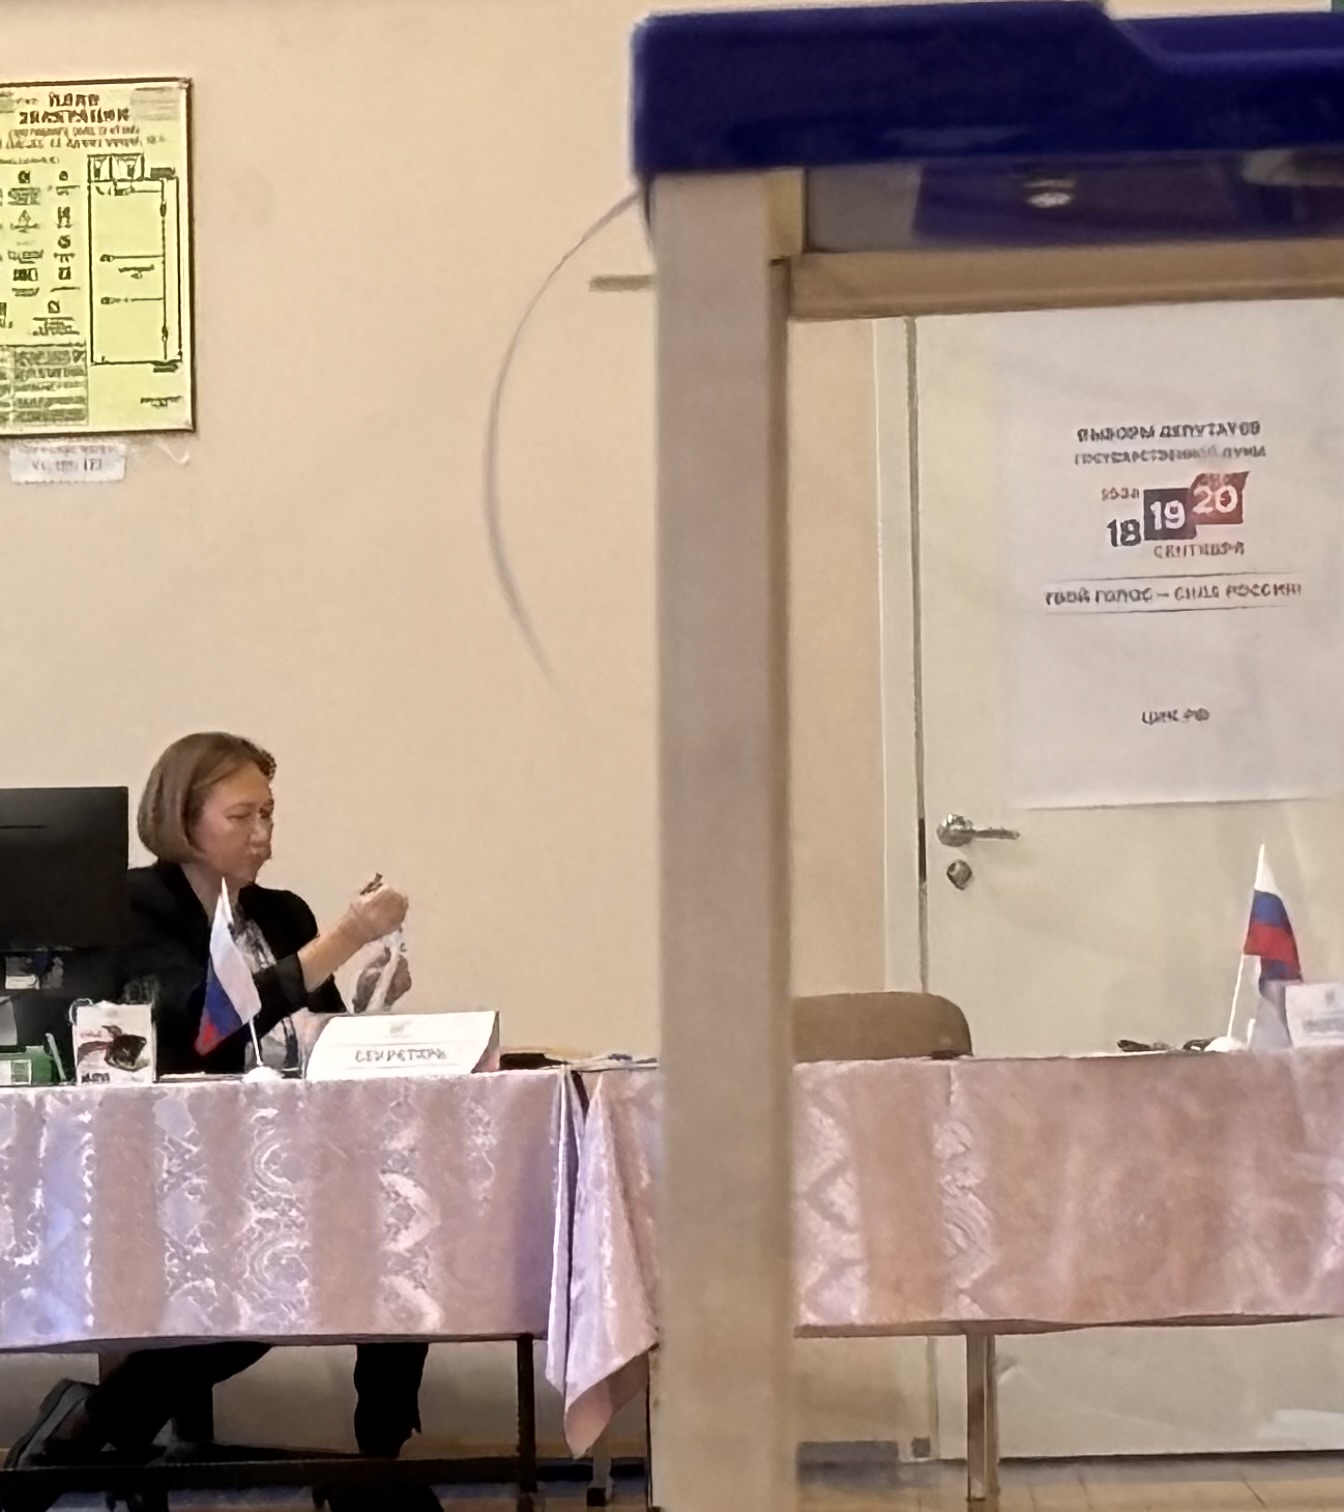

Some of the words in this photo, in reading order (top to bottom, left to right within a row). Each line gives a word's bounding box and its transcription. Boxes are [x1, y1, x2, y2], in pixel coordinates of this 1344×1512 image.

[1159, 420, 1261, 438] ДЕПУТАТОВ
[1074, 445, 1218, 465] ГОСУАРСТВЙ
[1106, 519, 1142, 547] 18
[1150, 500, 1186, 530] 19
[1193, 484, 1239, 514] 20
[1094, 587, 1154, 604] ГОЛОС
[1174, 583, 1220, 601] СИЛА
